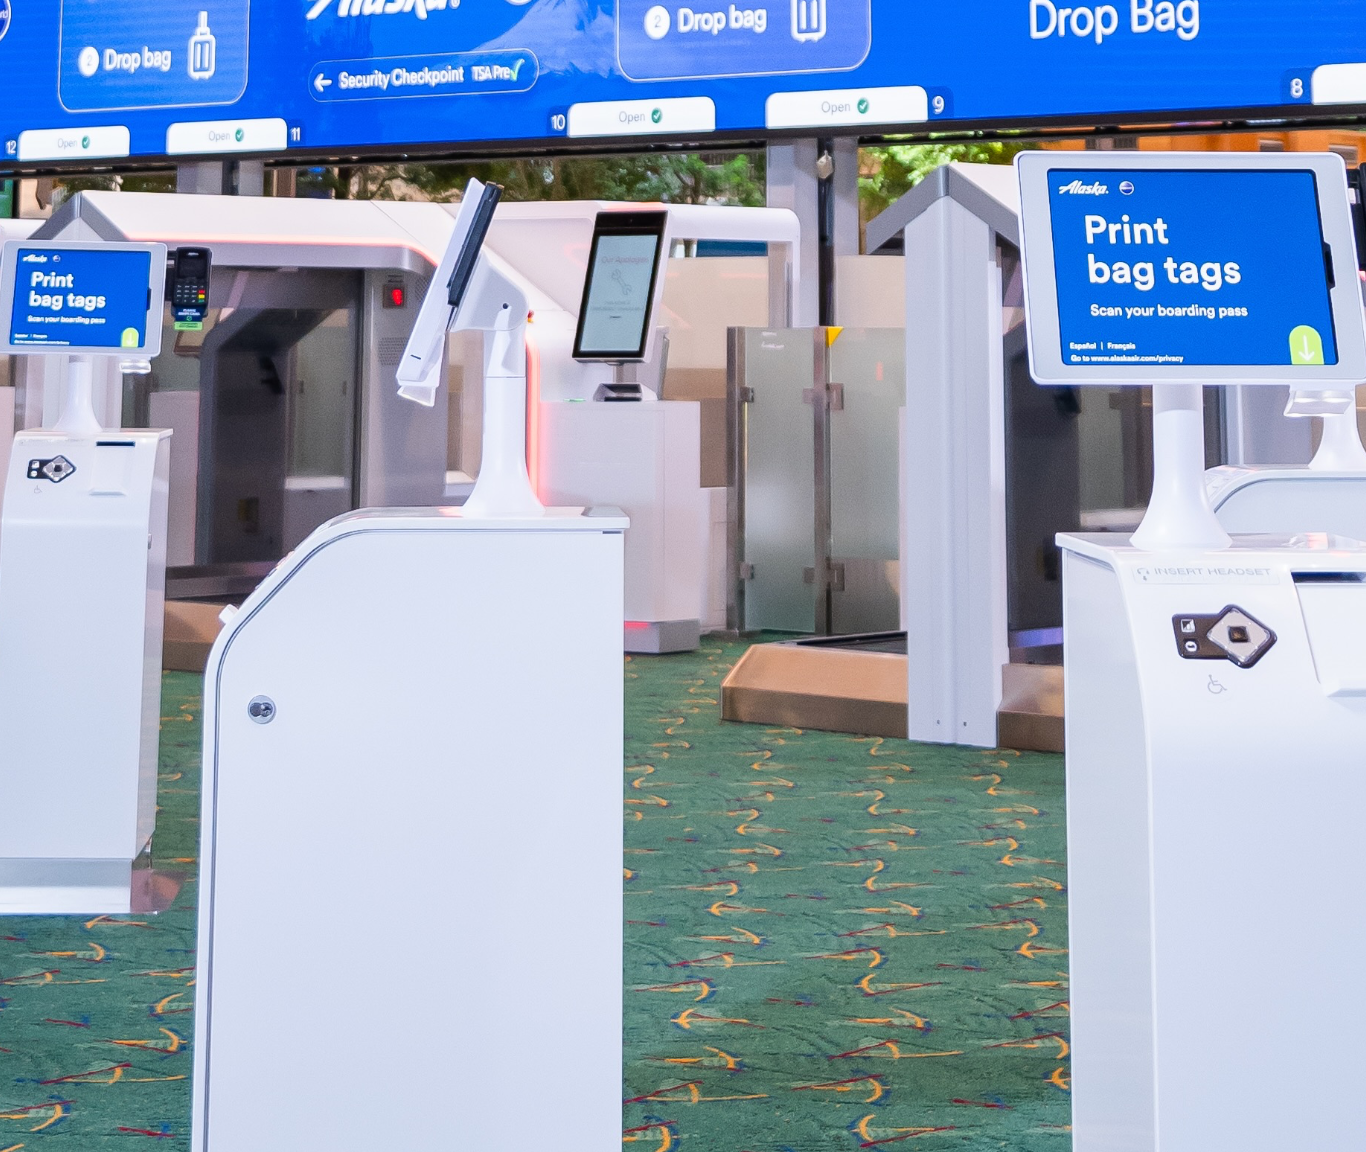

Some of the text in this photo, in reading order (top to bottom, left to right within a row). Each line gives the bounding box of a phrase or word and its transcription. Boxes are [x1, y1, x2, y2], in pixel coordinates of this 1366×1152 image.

[653, 4, 767, 36] 2 Drop bag
[103, 48, 139, 74] Drop
[142, 45, 172, 73] bag
[338, 70, 390, 91] Security
[391, 65, 464, 87] Checkpoint
[472, 66, 492, 81] TSA
[1290, 78, 1304, 99] 8
[821, 100, 851, 114] Open
[932, 95, 945, 115] 9
[551, 114, 565, 131] 10
[619, 111, 645, 124] Open
[208, 130, 230, 142] Open
[291, 126, 301, 142] 11
[6, 139, 17, 155] 12
[57, 137, 78, 150] Open
[1084, 214, 1169, 245] Print
[31, 271, 74, 288] Print
[1087, 253, 1242, 292] bag tags
[29, 290, 106, 311] bag tags
[1090, 304, 1248, 319] Scan your boarding pass
[60, 316, 90, 324] boarding
[1069, 342, 1135, 350] Español Français
[1154, 567, 1271, 577] INSERT HEADSET
